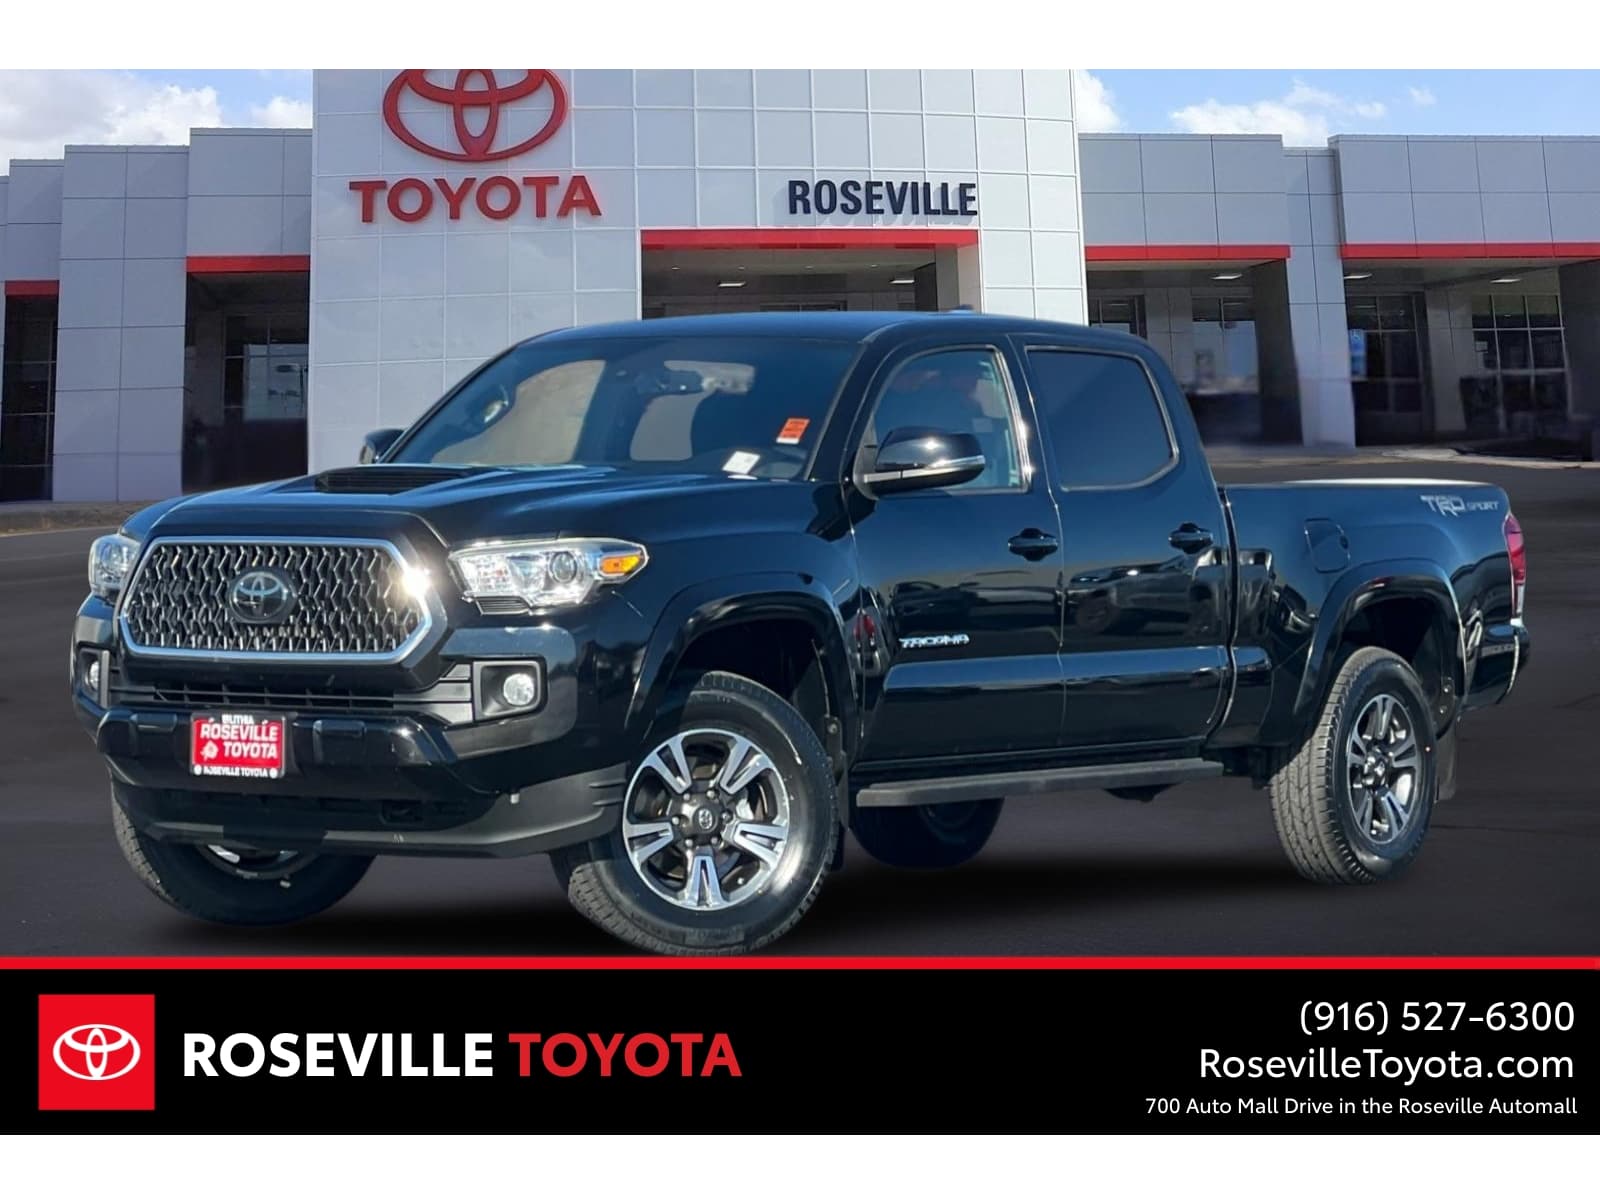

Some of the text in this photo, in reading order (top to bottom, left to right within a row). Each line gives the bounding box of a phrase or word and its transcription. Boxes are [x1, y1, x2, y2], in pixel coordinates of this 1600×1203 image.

[349, 175, 602, 223] TOYOTA
[788, 179, 978, 216] ROSEVILLE
[1420, 495, 1500, 518] TRD SPORT
[898, 633, 970, 648] TACOMA
[200, 723, 278, 742] ROSEVILLE
[223, 741, 278, 759] TOYOTA
[203, 765, 269, 778] ROSEVILLE TOYOTA
